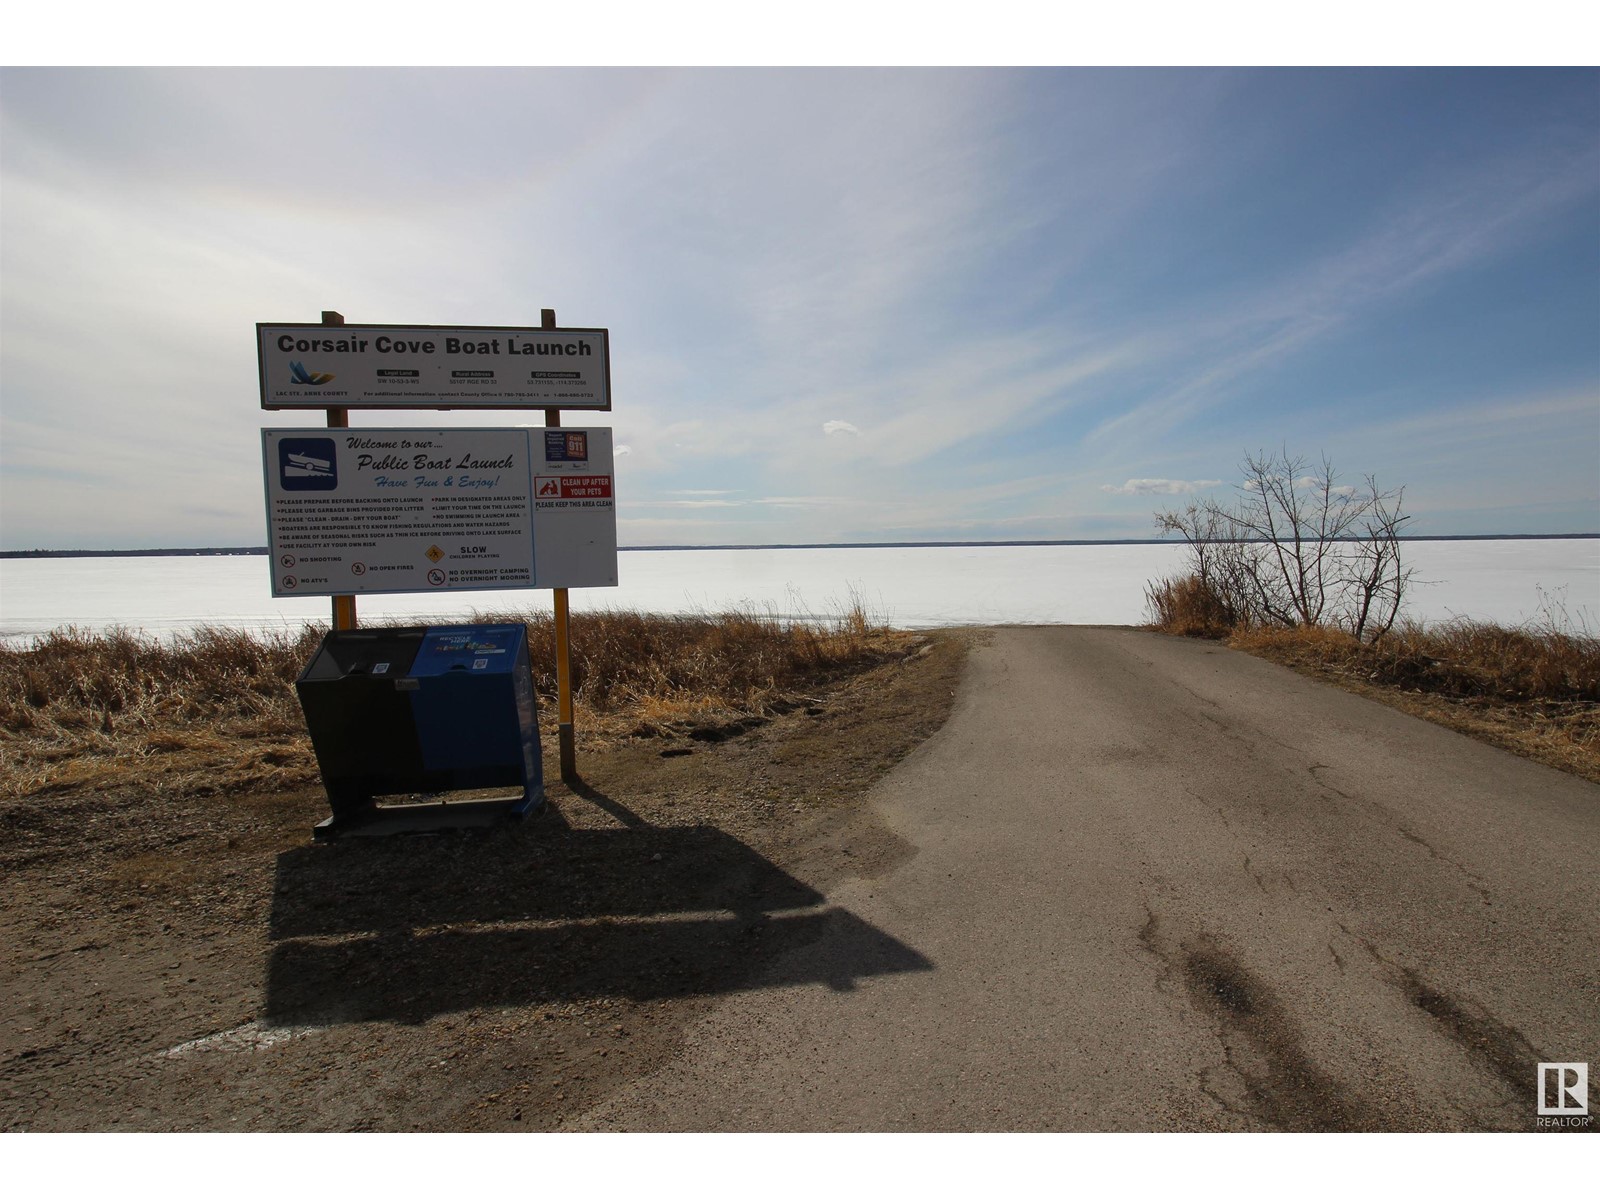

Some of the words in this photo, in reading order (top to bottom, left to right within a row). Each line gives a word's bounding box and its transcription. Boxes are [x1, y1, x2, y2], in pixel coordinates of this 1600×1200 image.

[278, 334, 368, 352] Corsair
[376, 336, 435, 354] Cove
[446, 338, 500, 354] Boat
[508, 339, 591, 356] Launch
[346, 437, 398, 449] Welcome
[401, 440, 411, 448] to
[569, 441, 583, 452] 911
[358, 454, 408, 470] Public
[413, 454, 452, 470] Boat
[456, 453, 514, 470] Launch
[374, 476, 408, 488] Have
[414, 476, 439, 488] Fun
[444, 476, 453, 486] &
[458, 475, 500, 489] Enjoy!
